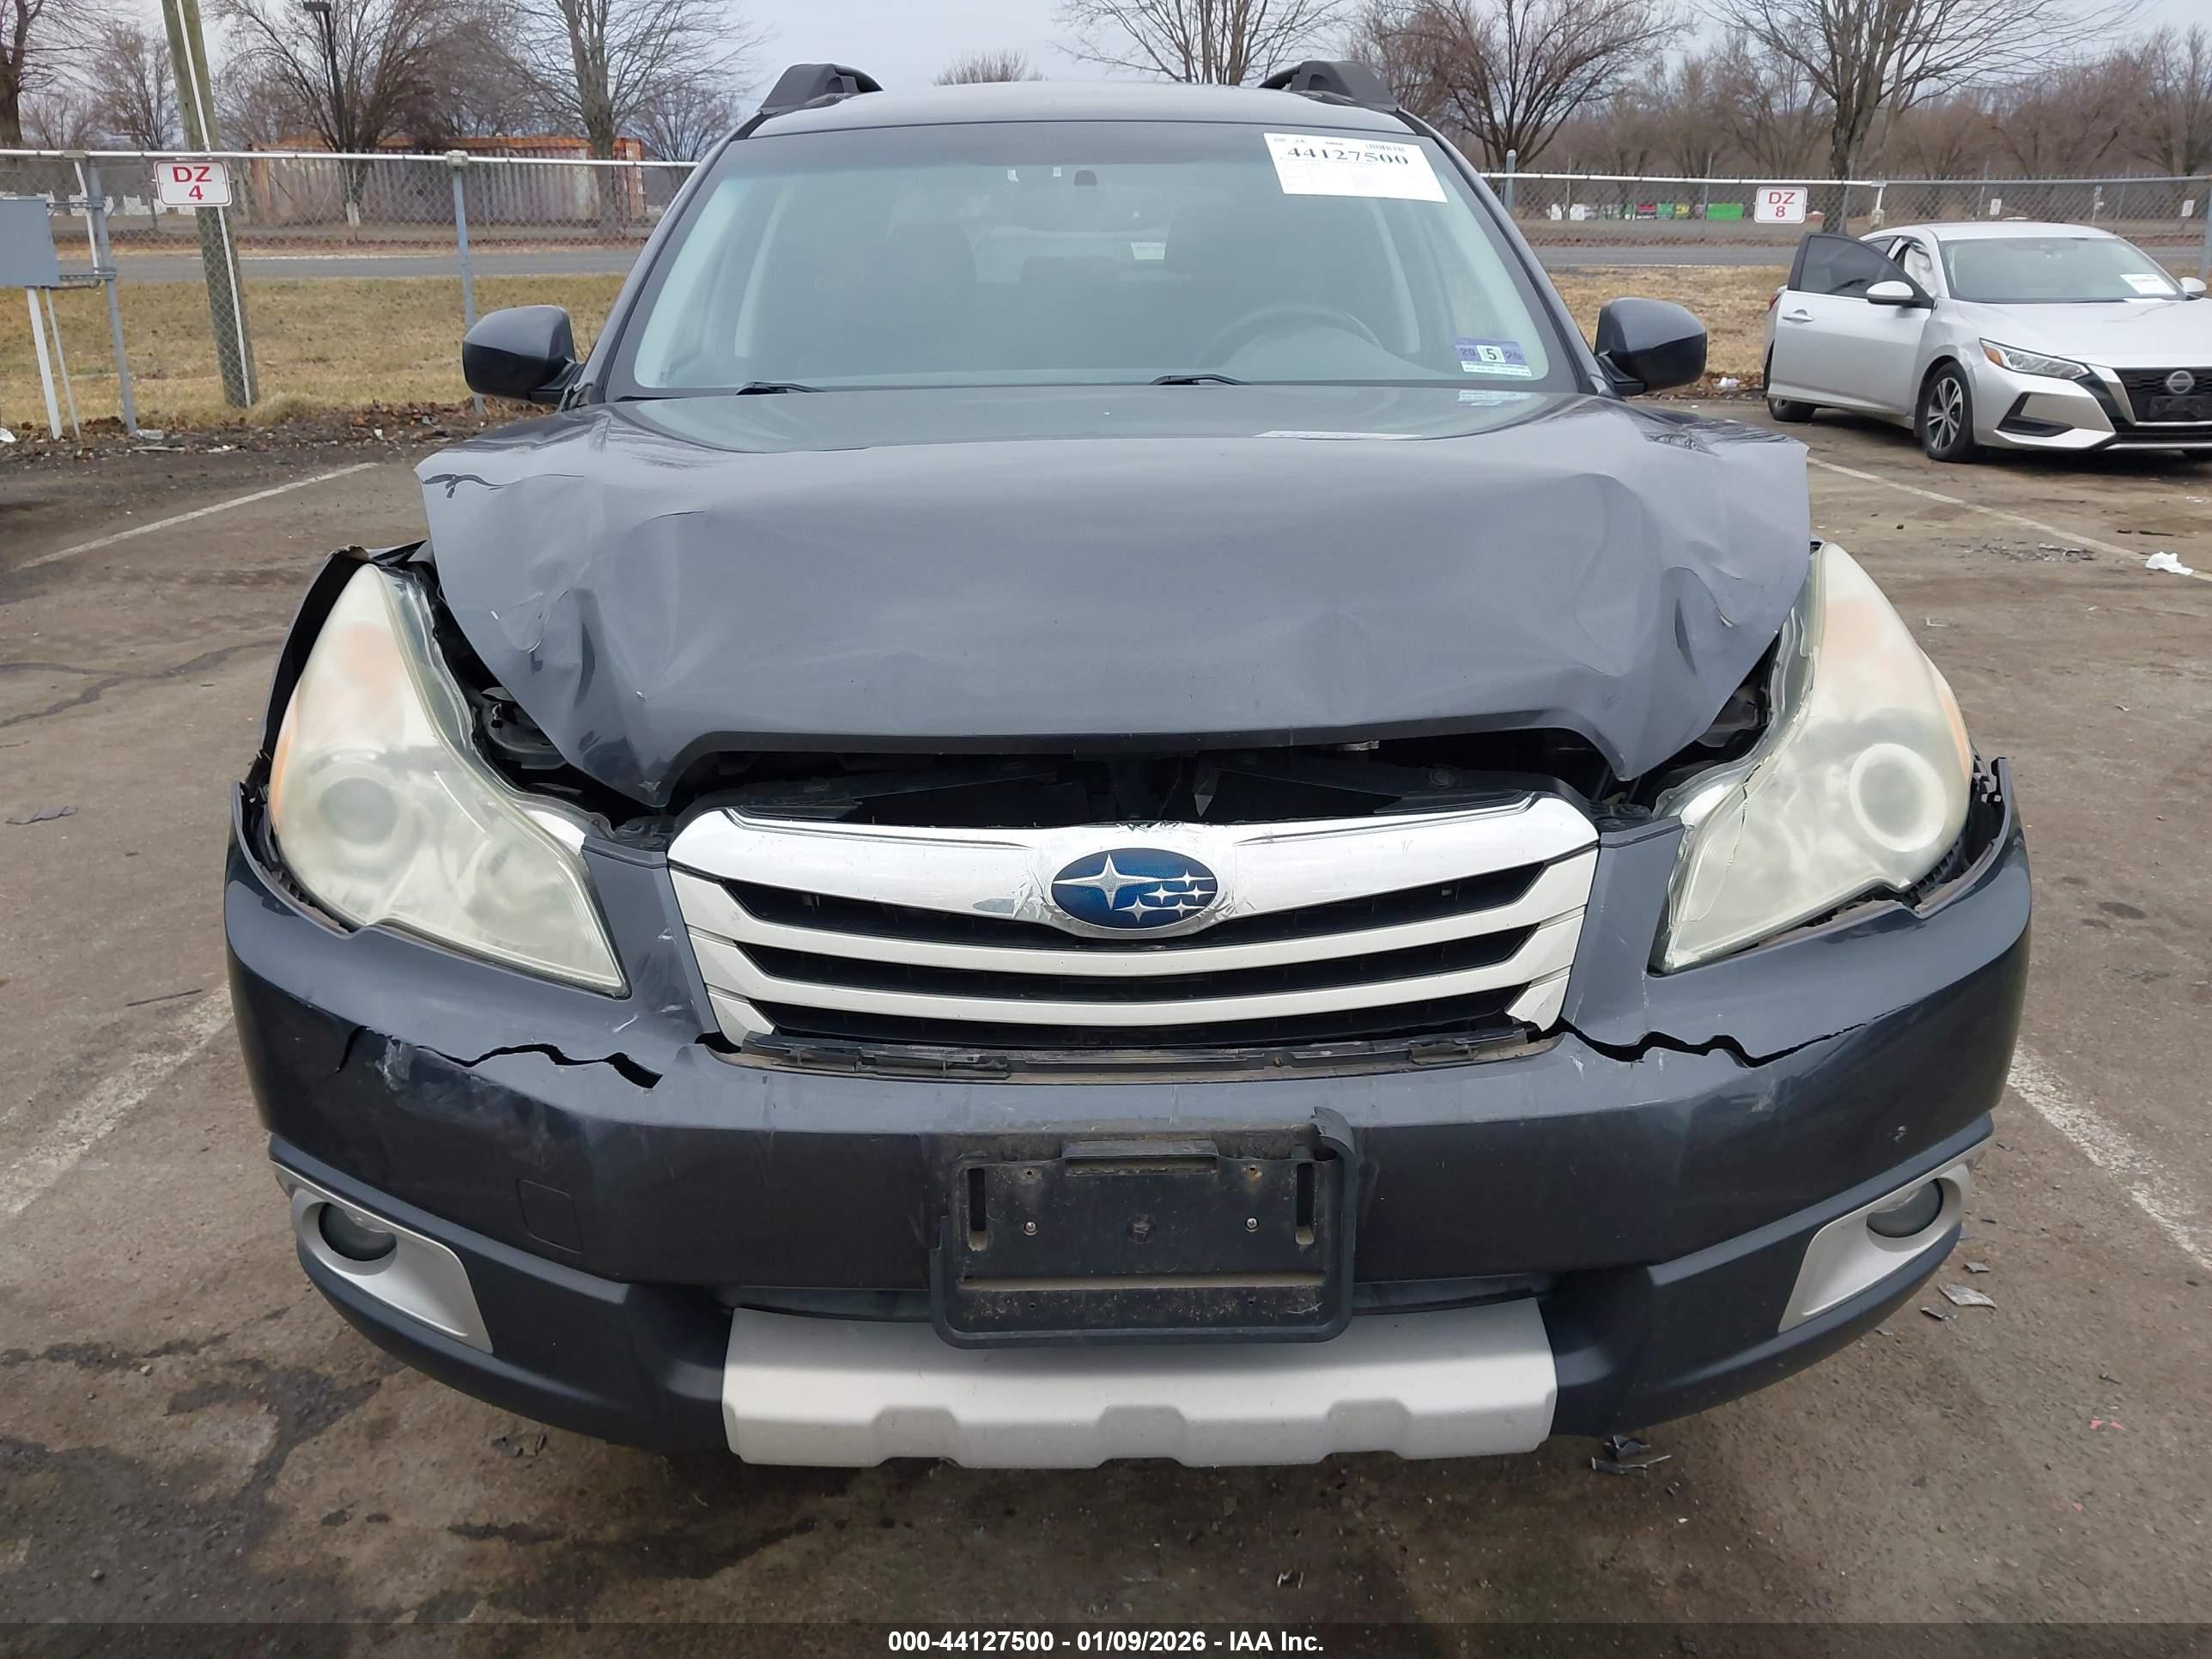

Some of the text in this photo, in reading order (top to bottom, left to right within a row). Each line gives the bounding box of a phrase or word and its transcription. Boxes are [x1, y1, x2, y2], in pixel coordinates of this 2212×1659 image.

[1287, 147, 1409, 166] 44127500
[172, 166, 212, 182] DZ
[188, 185, 204, 200] 4
[1768, 191, 1796, 204] DZ
[1775, 205, 1785, 217] 8
[1486, 347, 1498, 361] 5
